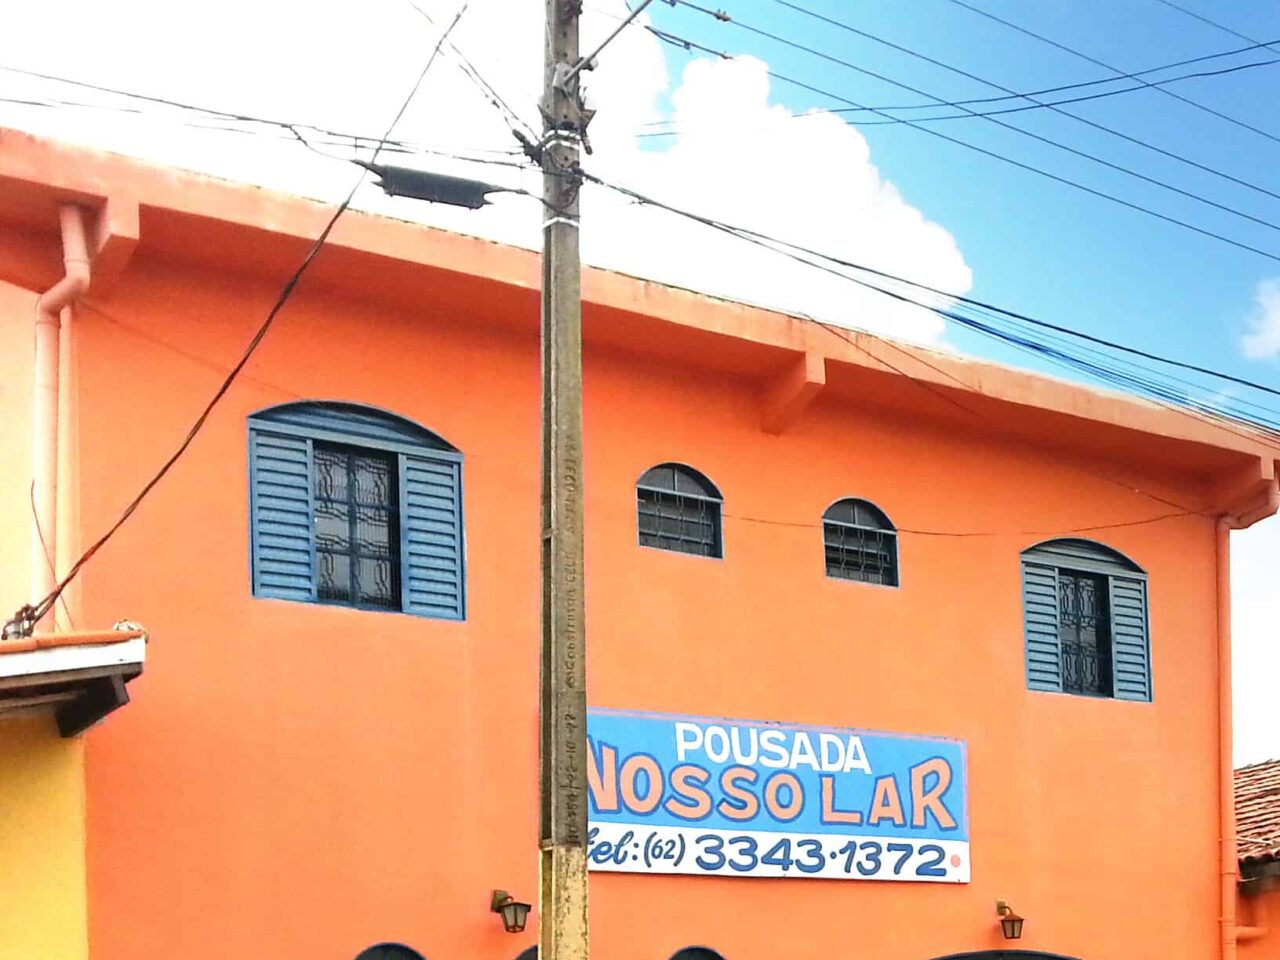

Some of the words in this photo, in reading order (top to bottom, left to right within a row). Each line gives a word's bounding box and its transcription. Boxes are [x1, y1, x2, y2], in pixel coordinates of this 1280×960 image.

[674, 721, 872, 775] POUSADA
[586, 733, 804, 823] NOSSO
[818, 755, 958, 832] LAR
[643, 831, 686, 868] (62)
